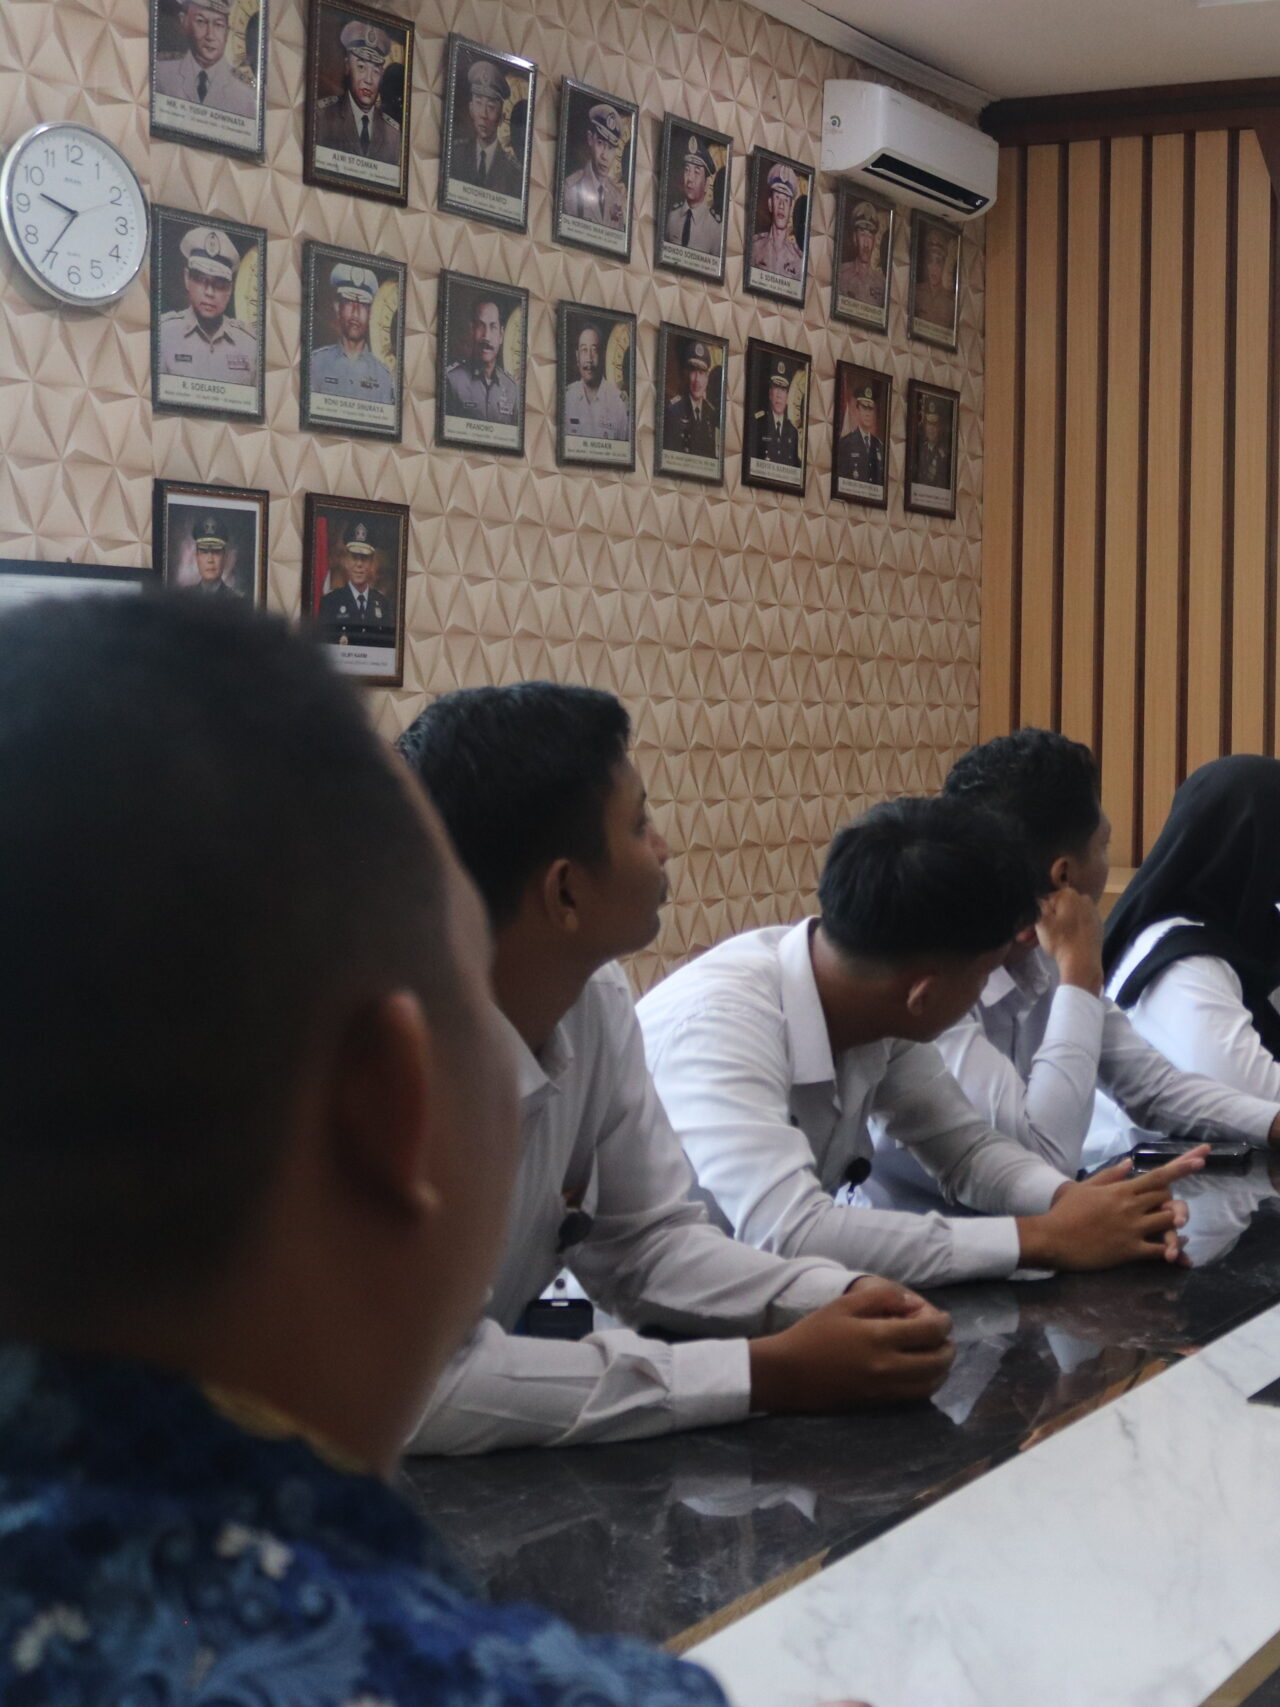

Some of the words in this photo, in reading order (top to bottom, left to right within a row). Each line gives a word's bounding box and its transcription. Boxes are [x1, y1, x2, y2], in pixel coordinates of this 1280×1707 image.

[44, 149, 56, 168] 11
[65, 144, 84, 165] 12
[24, 165, 44, 186] 10
[16, 192, 31, 212] 9
[109, 186, 123, 206] 2
[24, 224, 39, 244] 8
[114, 216, 128, 236] 3
[109, 244, 122, 263] 4
[67, 265, 81, 285] 6
[90, 259, 103, 279] 5
